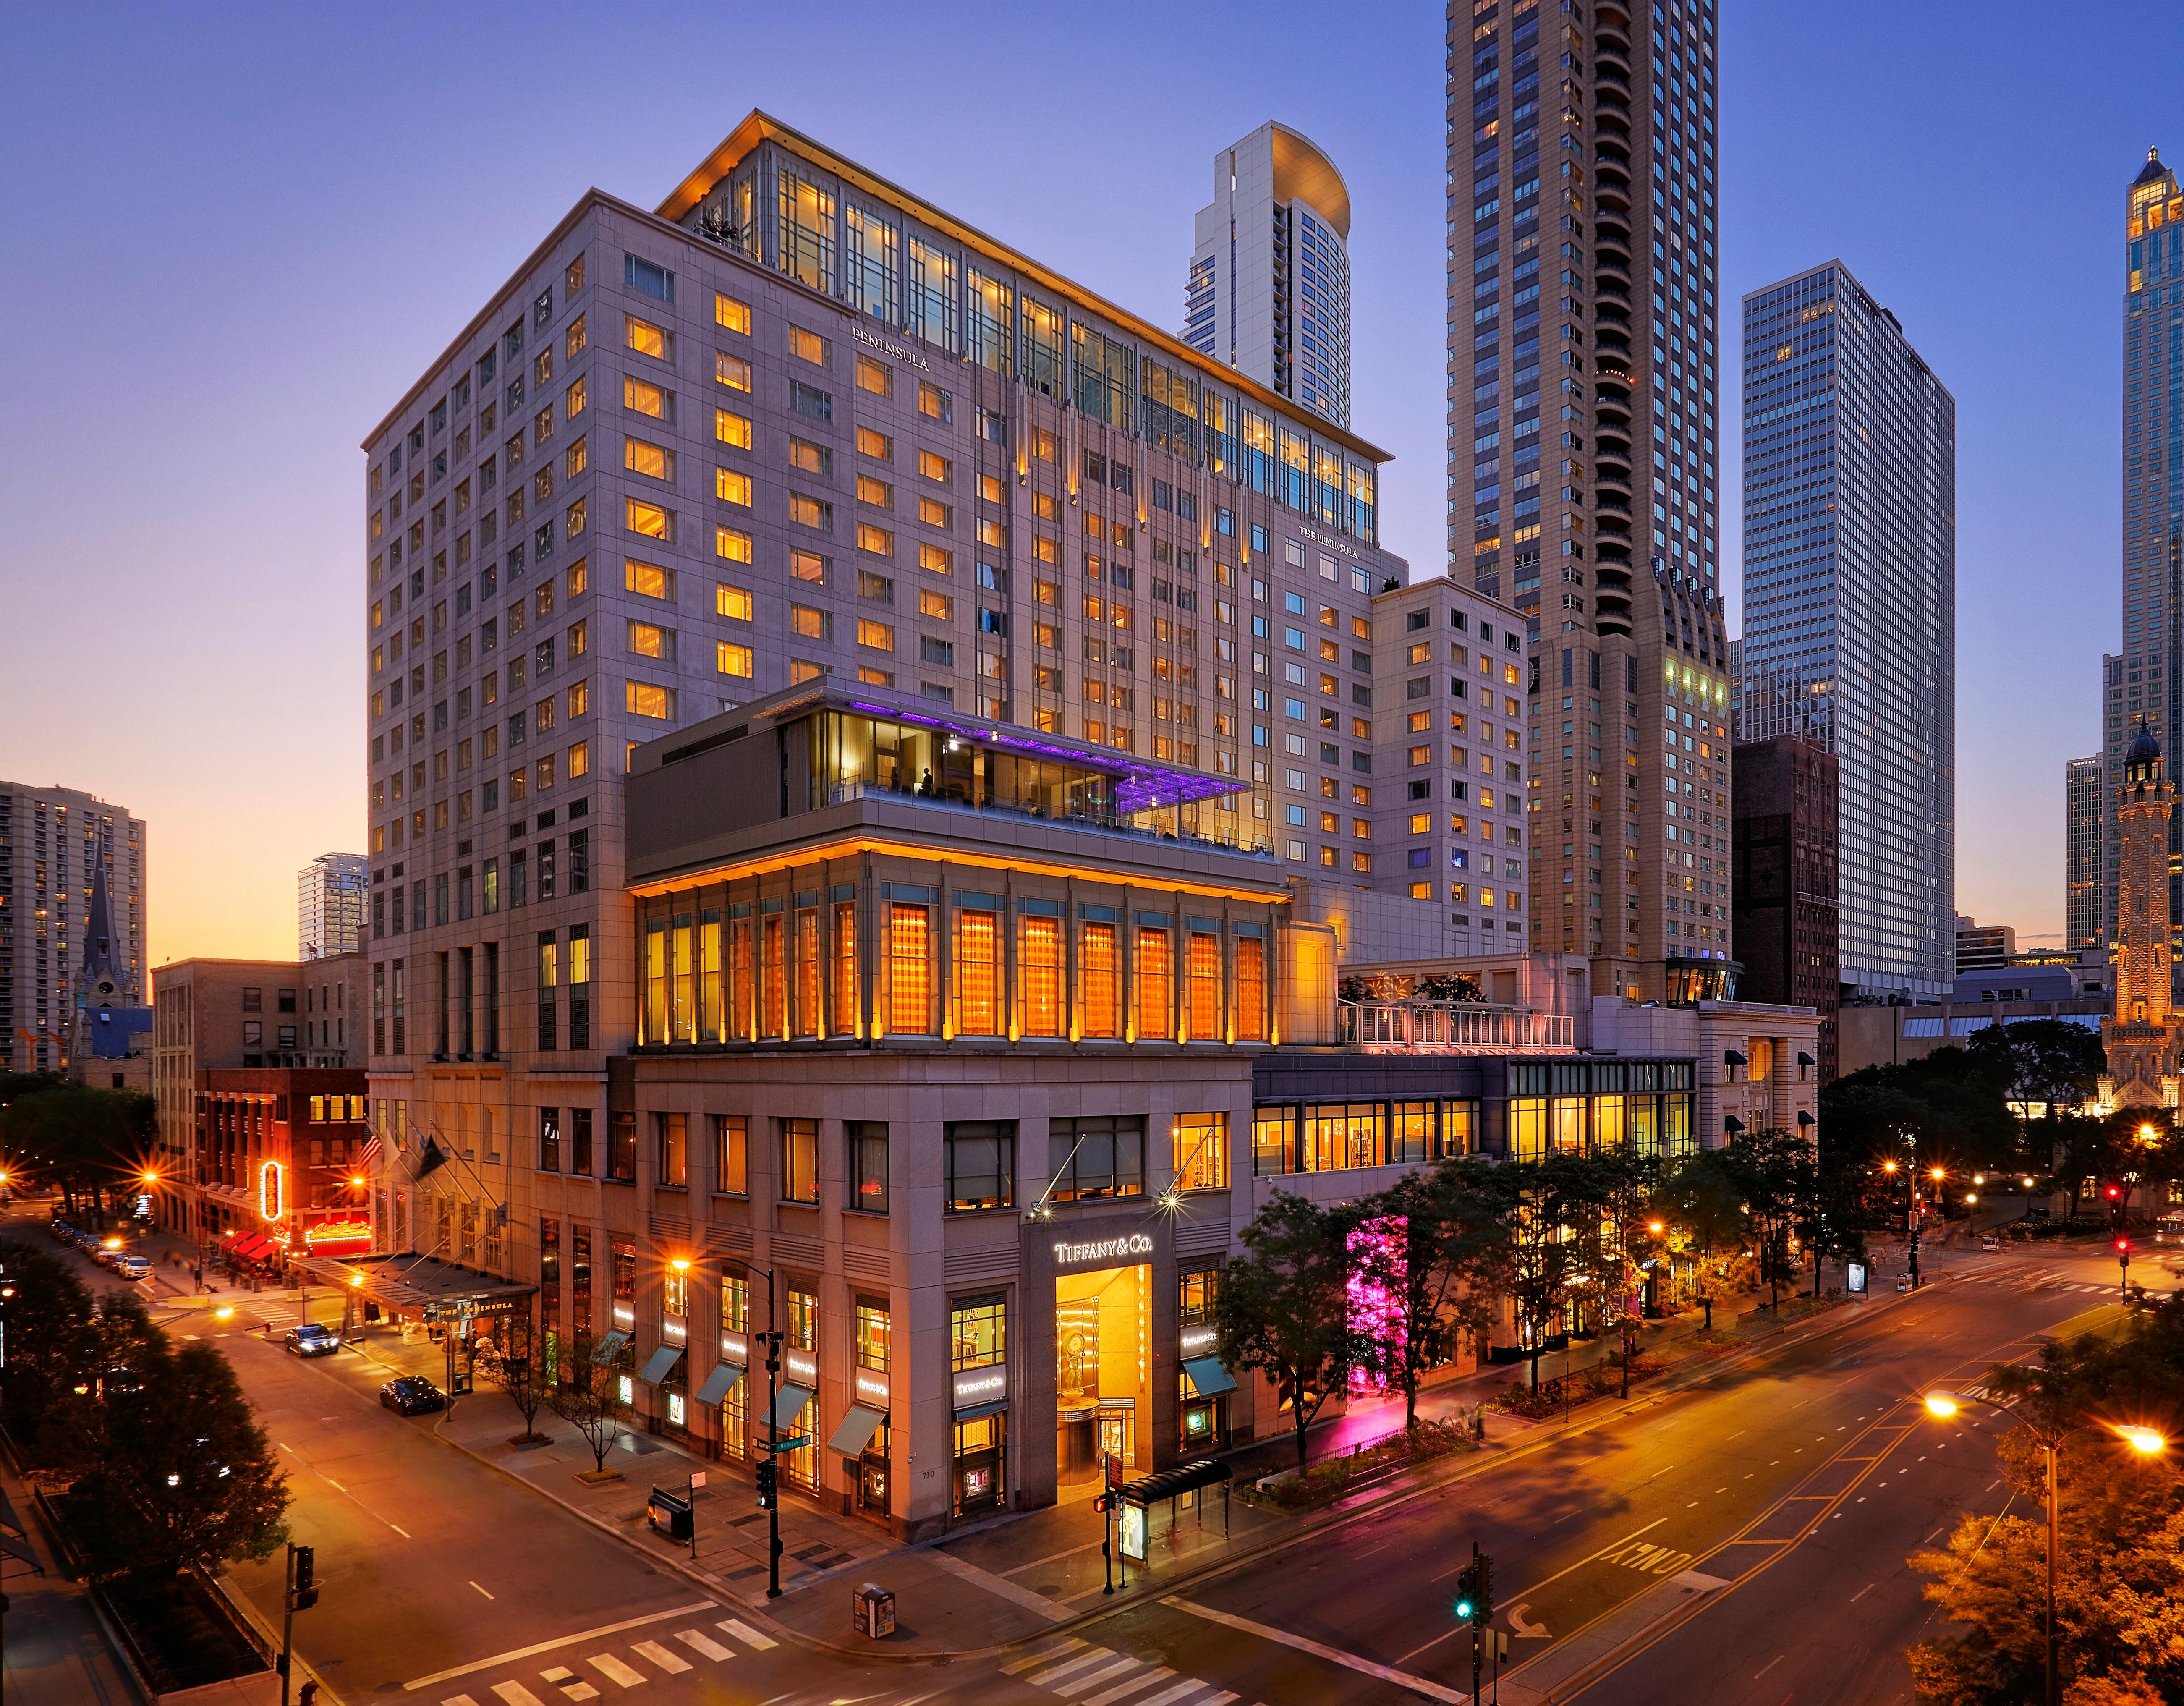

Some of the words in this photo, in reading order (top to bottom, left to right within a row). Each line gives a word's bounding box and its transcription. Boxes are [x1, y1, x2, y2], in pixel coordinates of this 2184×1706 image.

[852, 327, 930, 372] PENINSULA
[1299, 525, 1316, 541] THE
[1317, 534, 1359, 559] PENINSULA
[1117, 1237, 1129, 1255] &
[463, 1303, 513, 1313] PENINSULA
[781, 1440, 798, 1449] Michigan
[923, 1470, 934, 1480] 730
[1598, 1541, 1692, 1575] ONLY
